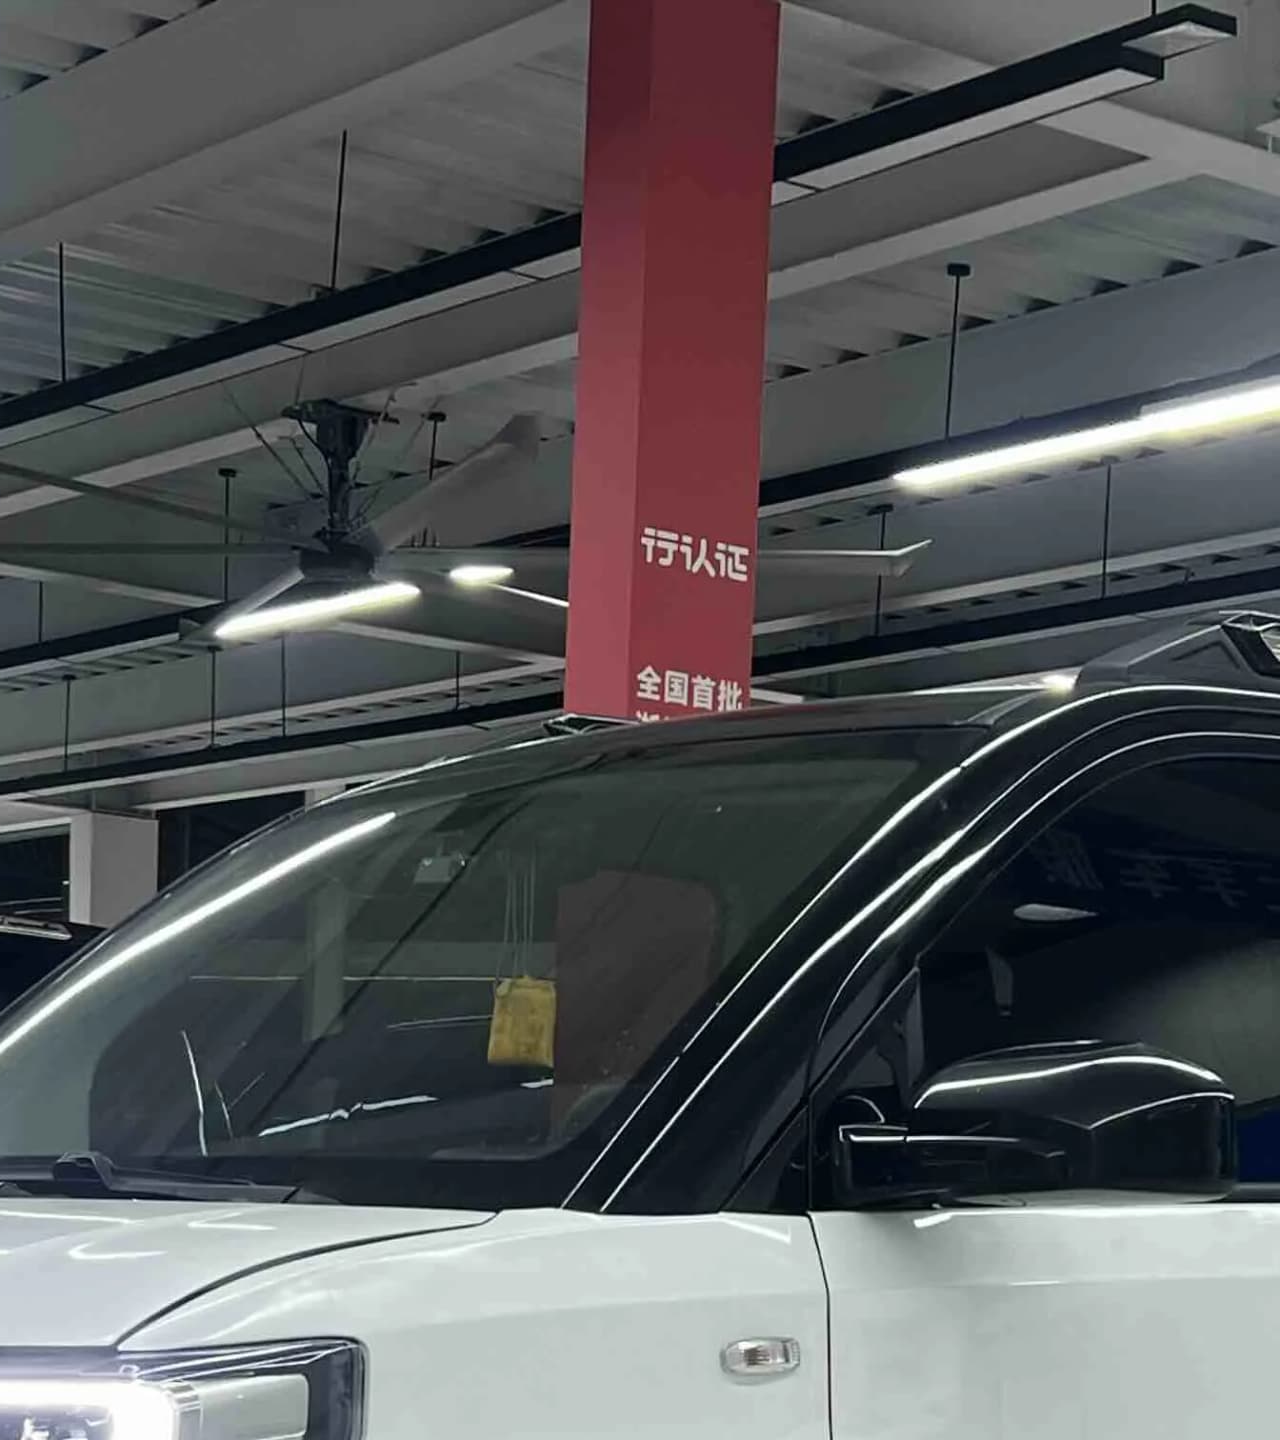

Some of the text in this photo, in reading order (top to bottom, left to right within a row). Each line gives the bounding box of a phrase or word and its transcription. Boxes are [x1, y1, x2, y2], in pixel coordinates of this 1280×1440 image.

[640, 526, 750, 582] 行认证
[636, 665, 743, 713] 全国首批
